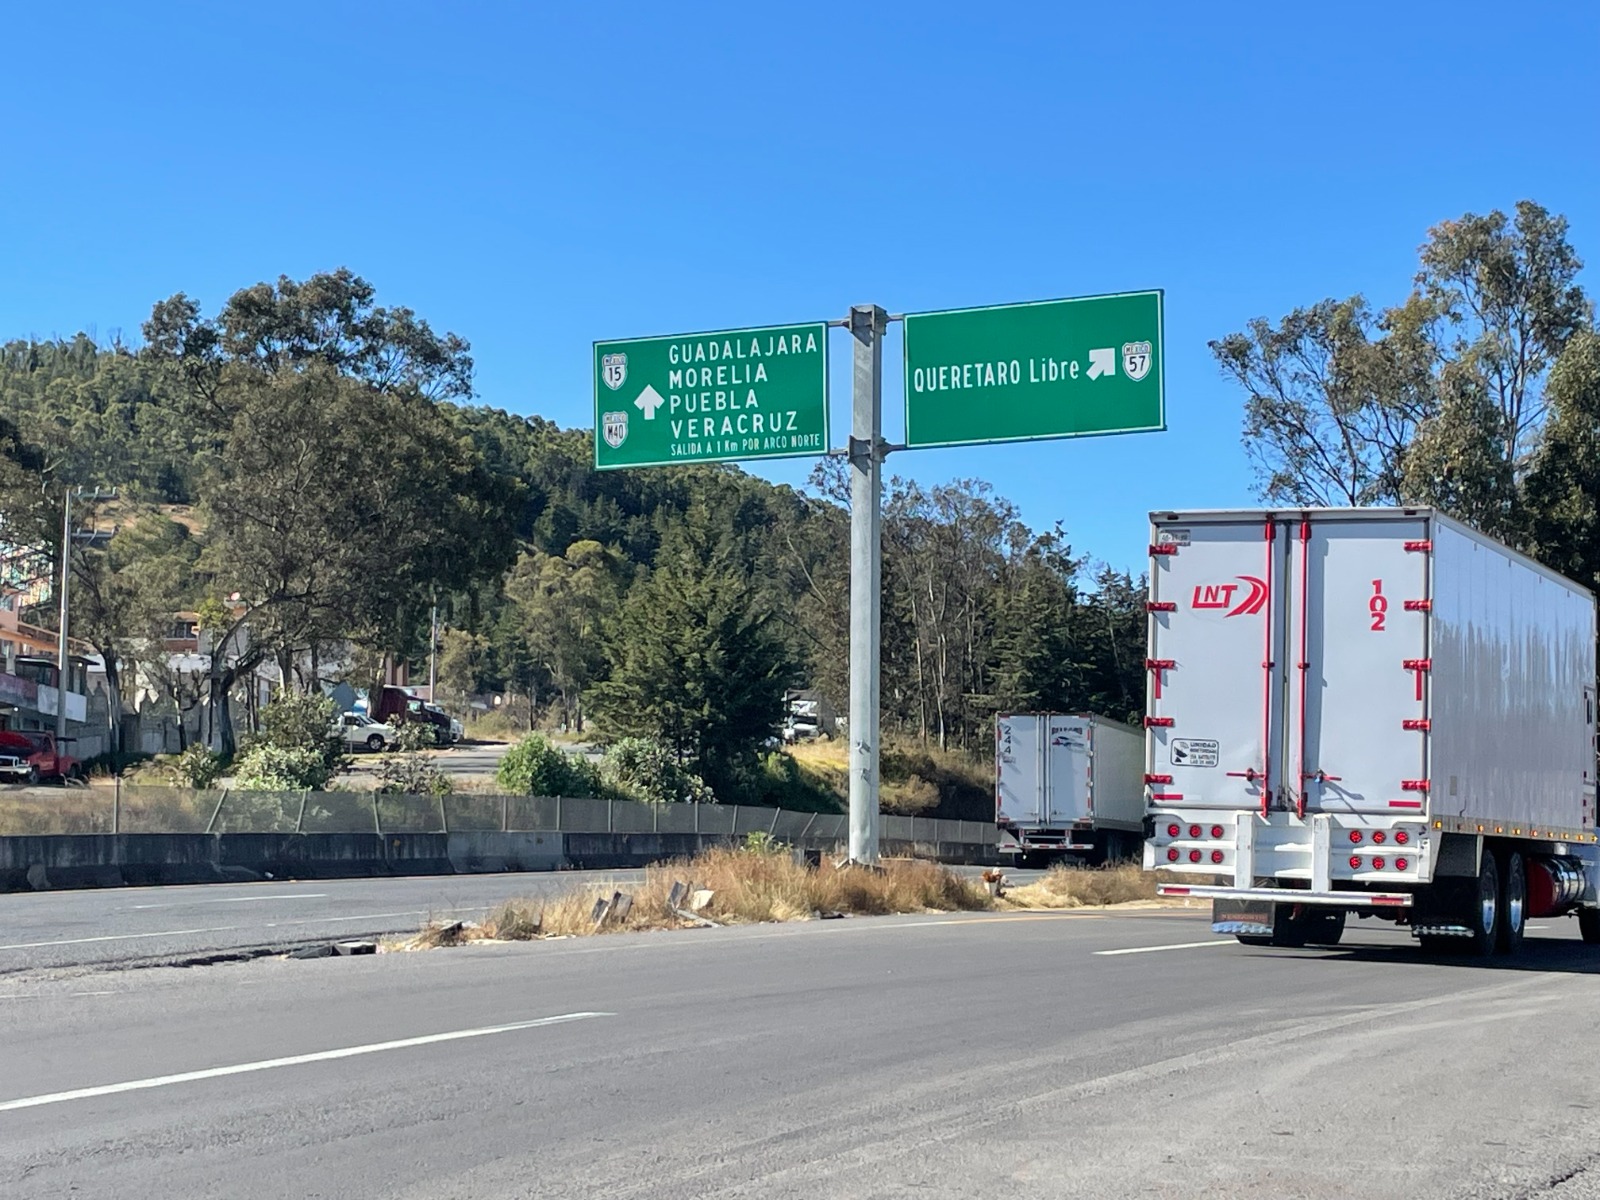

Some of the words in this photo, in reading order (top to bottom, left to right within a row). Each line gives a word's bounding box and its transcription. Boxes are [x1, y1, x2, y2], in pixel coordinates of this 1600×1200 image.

[669, 333, 817, 364] GUADALAJARA
[609, 366, 622, 381] 15
[669, 363, 768, 389] MORELIA
[914, 360, 1020, 392] QUERETARO
[1030, 358, 1079, 383] Libre
[1129, 355, 1146, 372] 57
[670, 389, 758, 414] PUEBLA
[607, 424, 624, 440] M40
[671, 411, 797, 439] VERACRUZ
[671, 442, 702, 456] SALIDA
[706, 441, 713, 454] A
[717, 441, 721, 453] 1
[724, 440, 738, 452] Km
[742, 438, 759, 451] POR
[763, 436, 787, 450] ARCO
[791, 433, 820, 448] NORTE
[1192, 585, 1238, 609] LNT
[1370, 579, 1387, 631] 102
